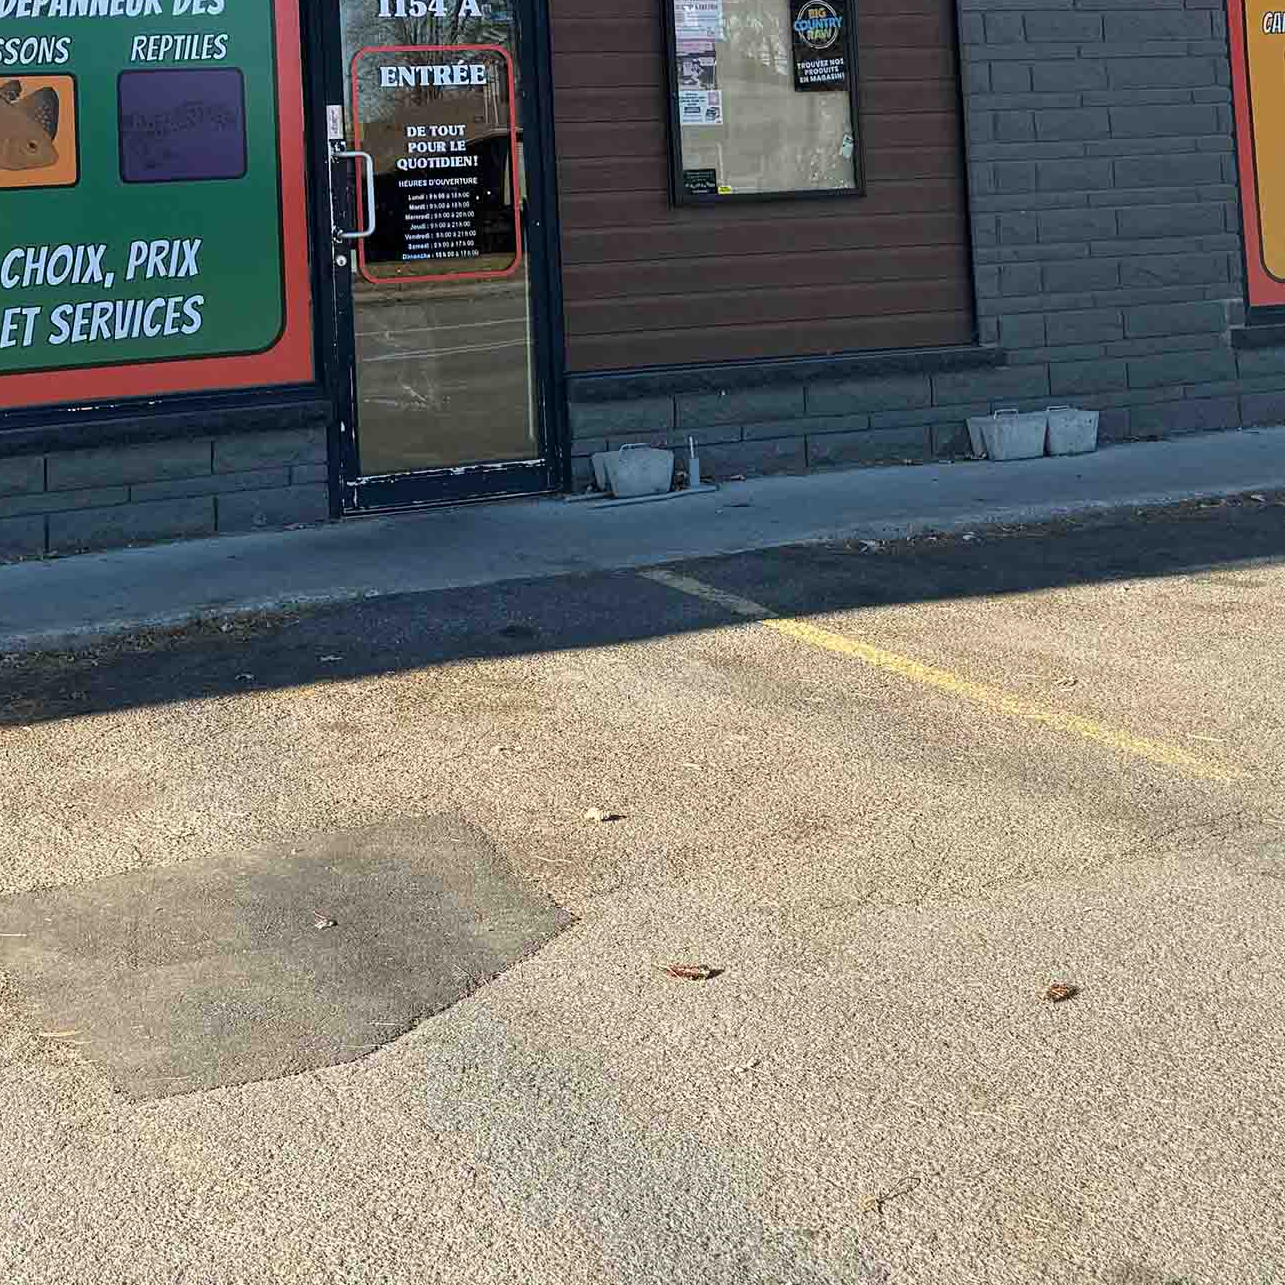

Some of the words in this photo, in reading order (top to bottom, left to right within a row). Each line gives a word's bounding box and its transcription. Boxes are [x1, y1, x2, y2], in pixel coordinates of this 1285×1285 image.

[794, 16, 843, 31] COUNTRY
[130, 33, 229, 62] REPTILES
[379, 59, 487, 88] ENTRÉE
[406, 126, 426, 138] DE
[429, 124, 466, 136] TOUT
[407, 142, 446, 153] POUR
[450, 140, 467, 152] LE
[396, 155, 479, 171] QUOTIDIEN!
[124, 237, 203, 282] PRIX
[48, 294, 205, 346] SERVICES
